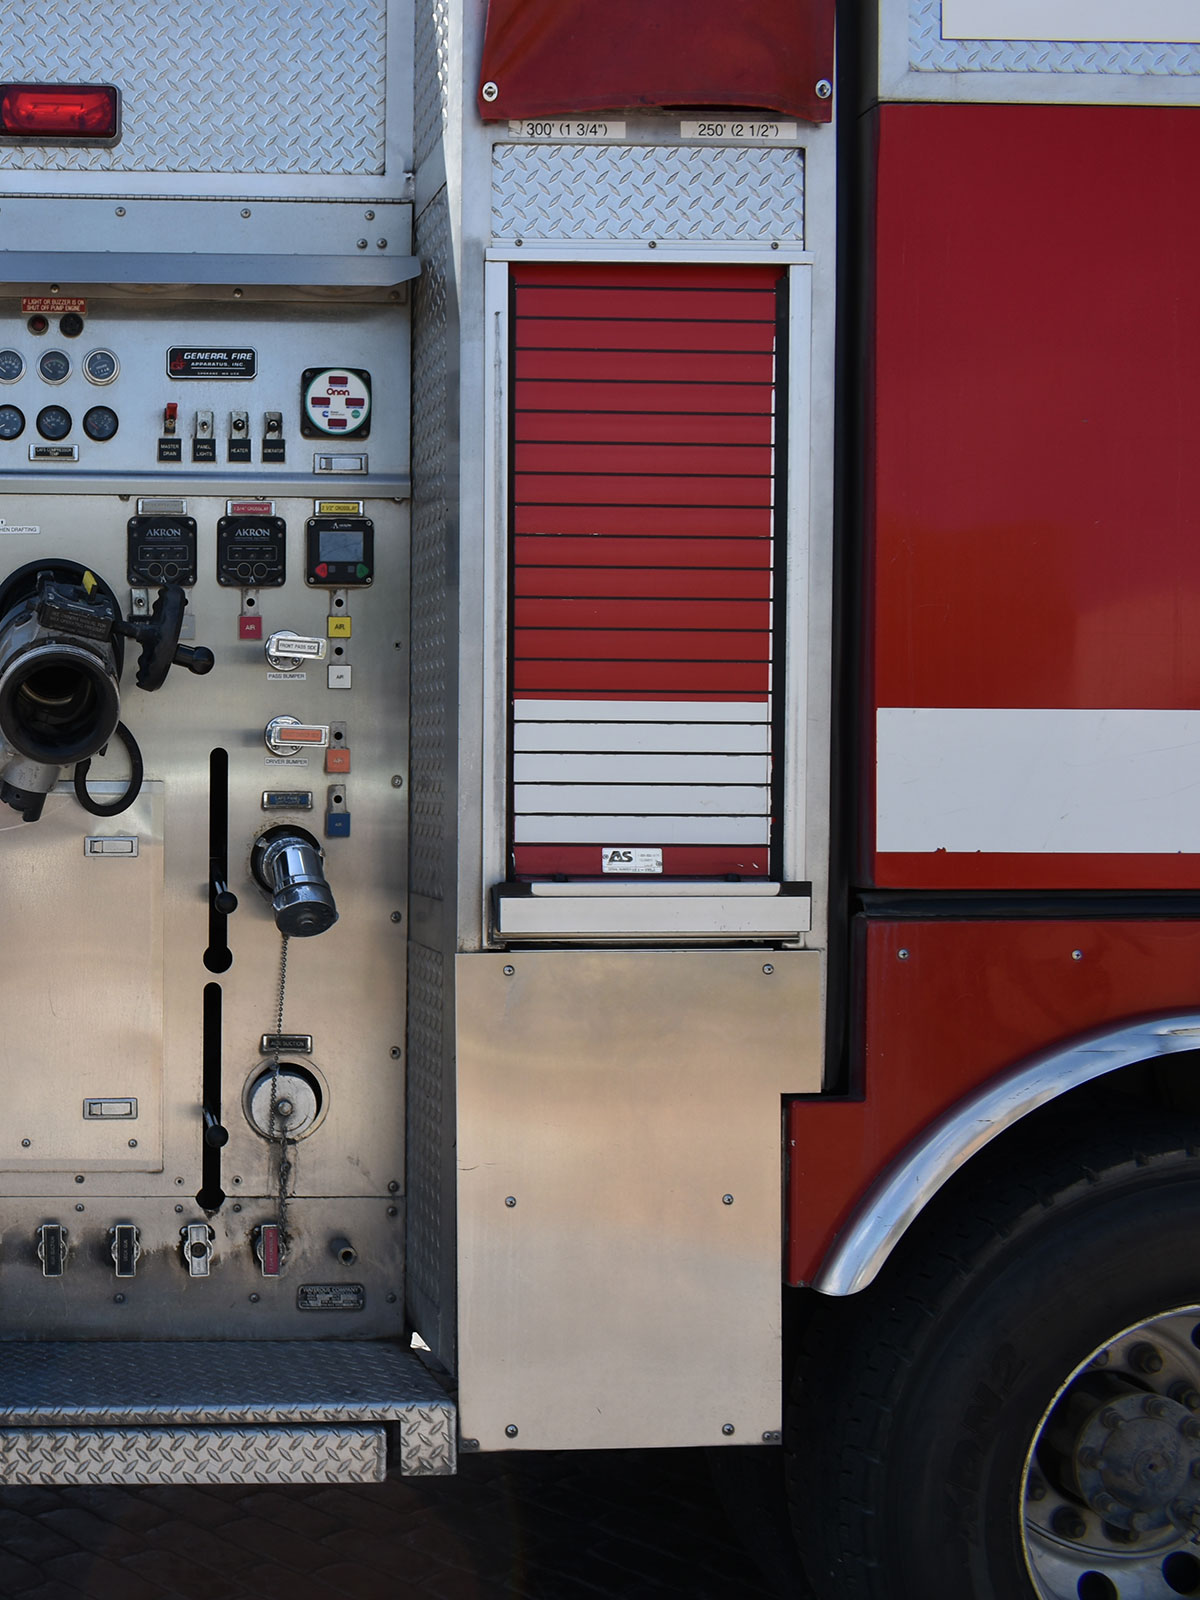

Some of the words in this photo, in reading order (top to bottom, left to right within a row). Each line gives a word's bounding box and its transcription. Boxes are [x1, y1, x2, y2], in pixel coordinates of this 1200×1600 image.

[526, 123, 555, 137] 300'
[559, 123, 571, 137] (1
[577, 123, 608, 137] 3/4")
[698, 124, 726, 138] 250'
[731, 124, 743, 138] (2
[750, 124, 779, 138] 1/2")
[184, 352, 228, 360] GENERAL
[326, 388, 350, 396] Onan
[146, 528, 181, 536] AKRON
[235, 528, 270, 536] AKRON
[608, 850, 633, 862] AS
